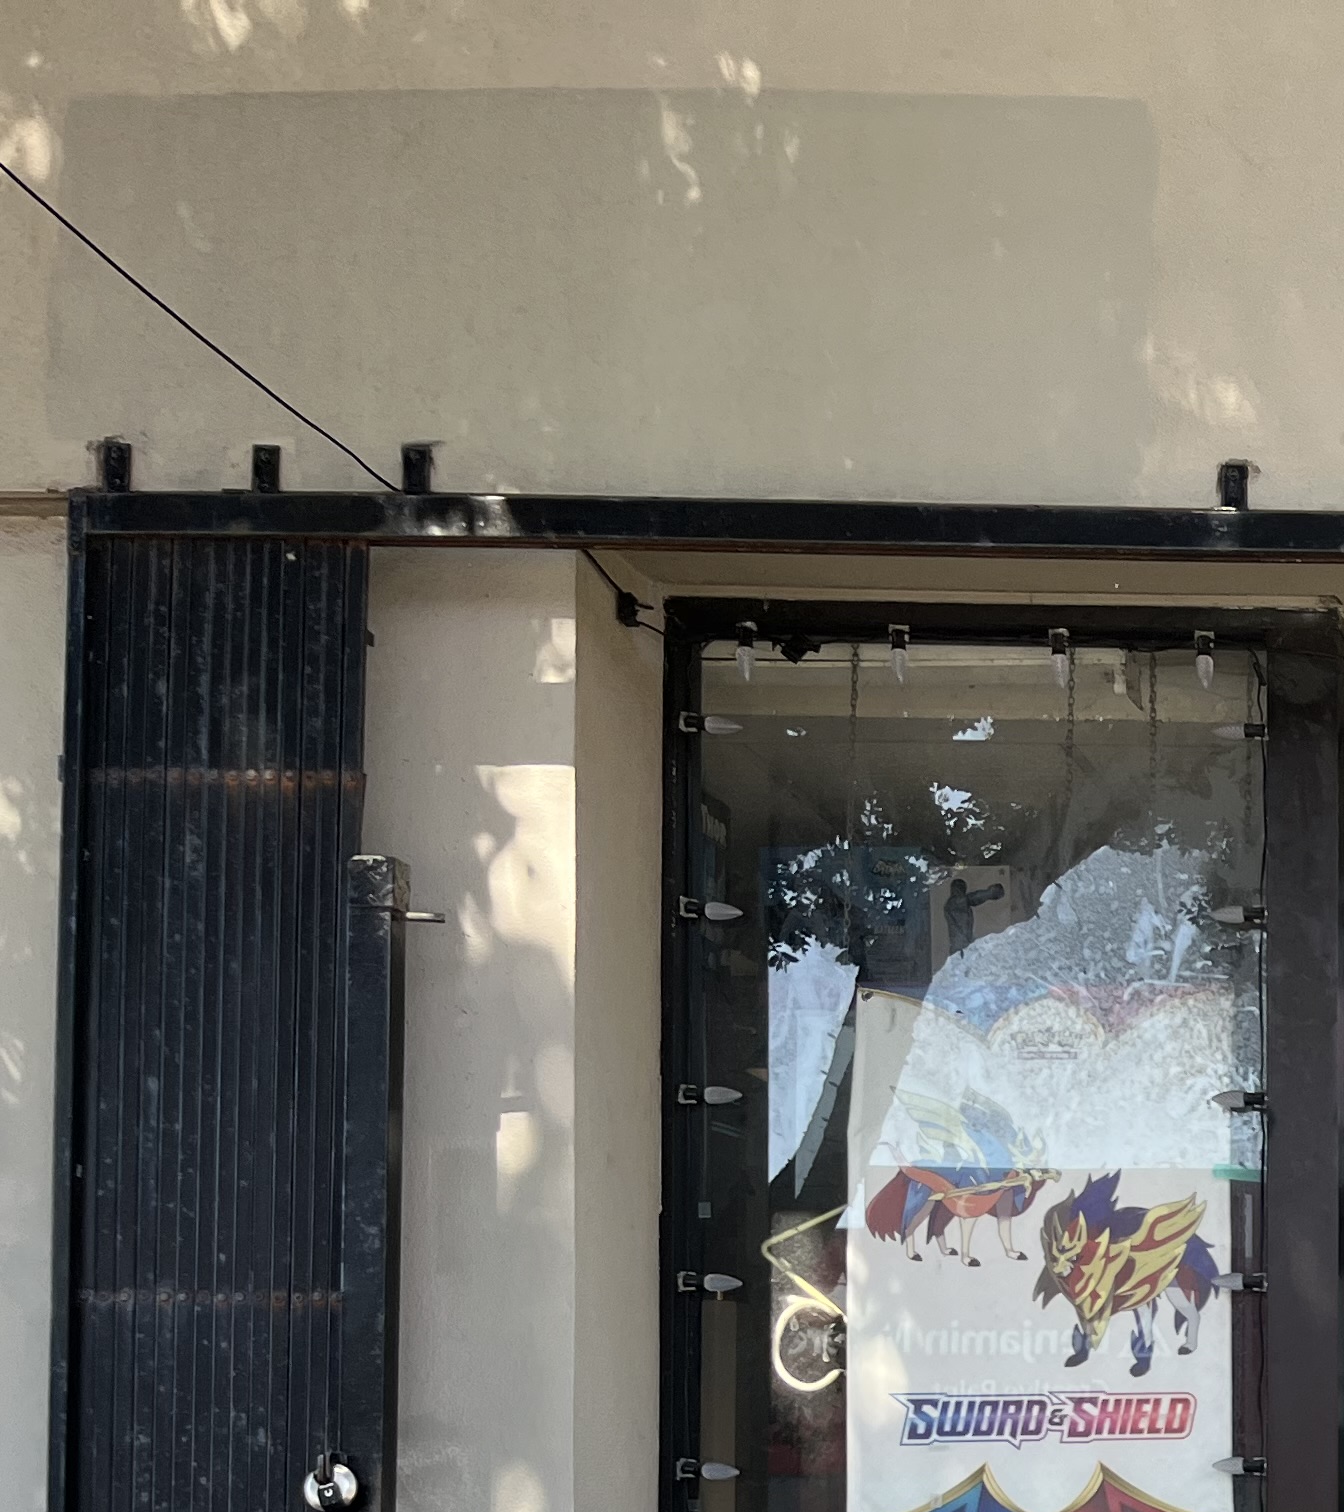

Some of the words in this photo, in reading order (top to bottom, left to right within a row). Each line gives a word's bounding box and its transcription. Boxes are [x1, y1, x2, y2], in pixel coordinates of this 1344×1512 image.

[903, 1397, 1047, 1443] SWORD
[1047, 1407, 1068, 1429] &
[1066, 1395, 1195, 1440] SHIELD
